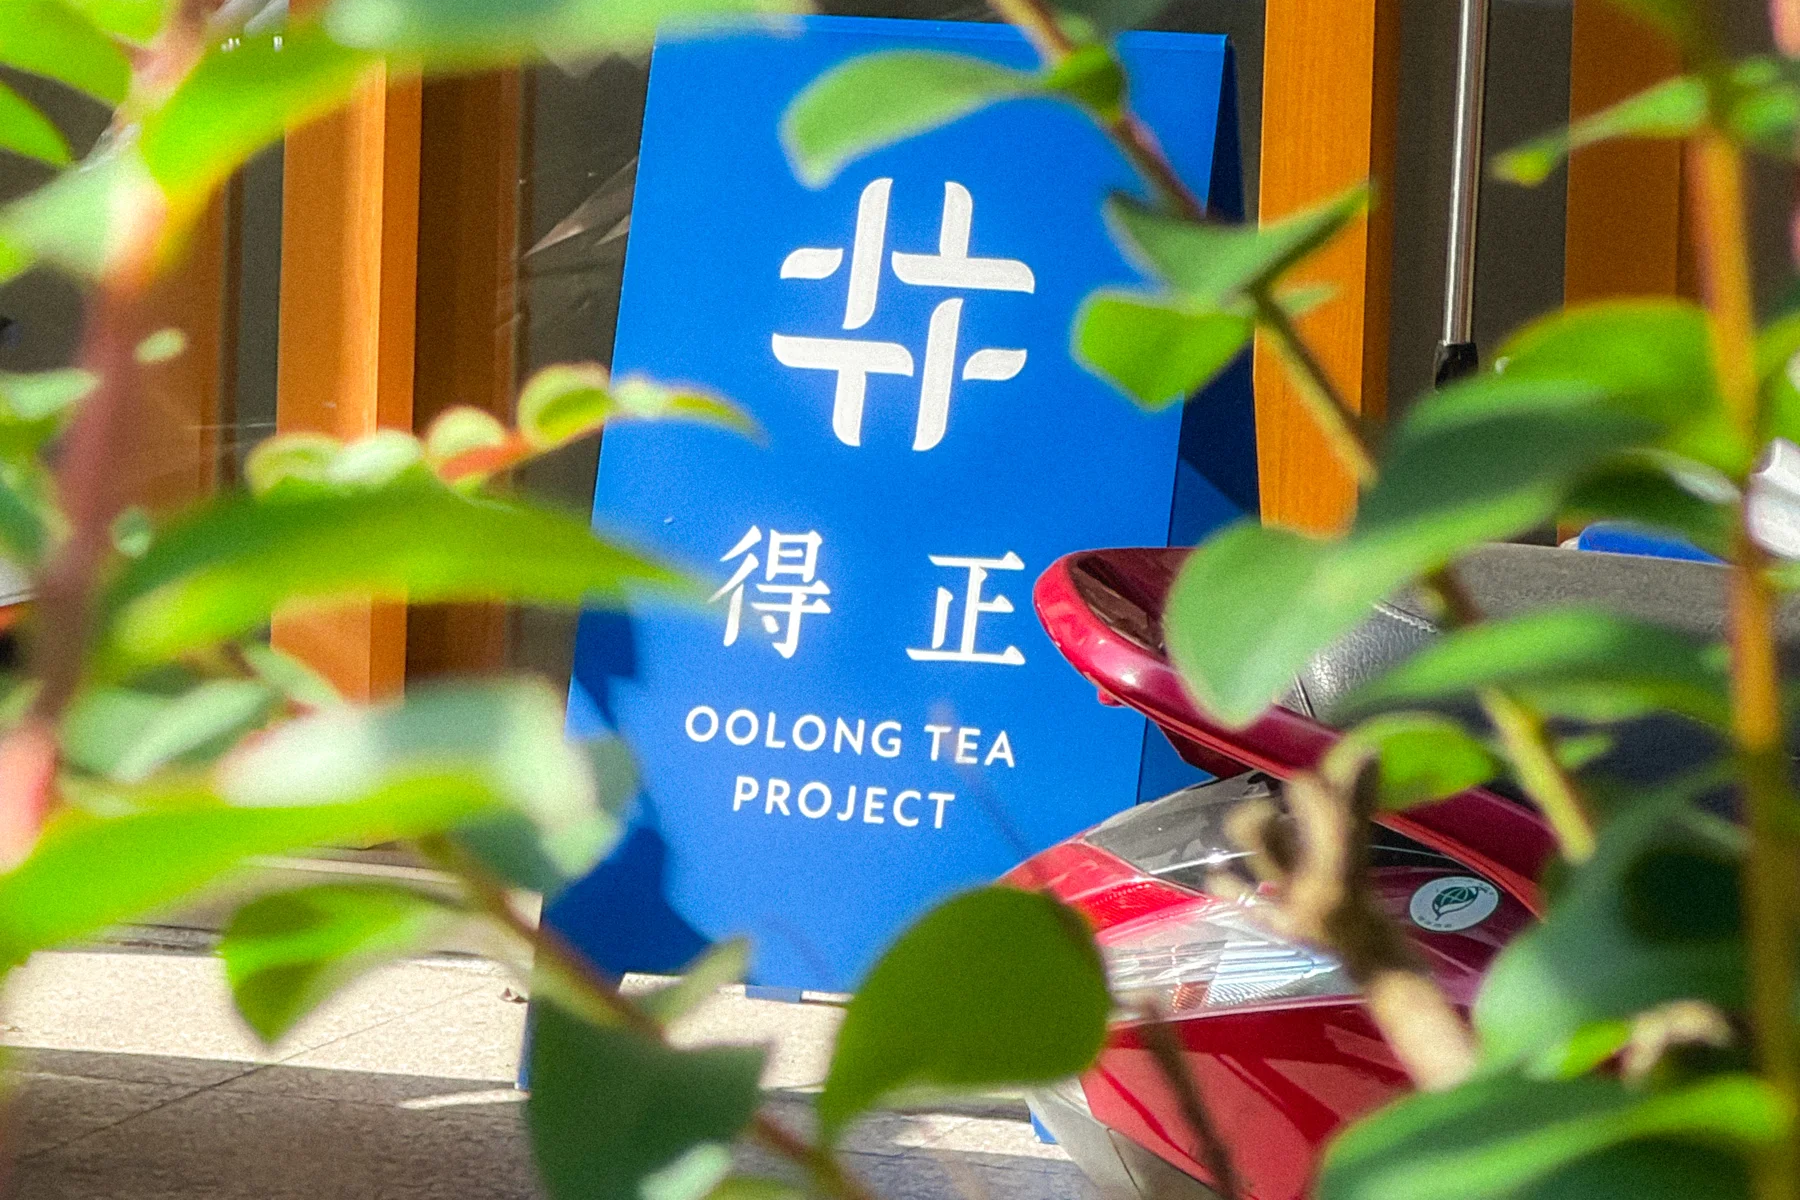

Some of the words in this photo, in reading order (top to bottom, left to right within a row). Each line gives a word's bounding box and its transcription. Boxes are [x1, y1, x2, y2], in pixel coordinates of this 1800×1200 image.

[707, 525, 1026, 666] 得正
[685, 705, 902, 758] OOLONG
[924, 724, 1016, 768] TEA
[732, 775, 956, 830] PROJECT
